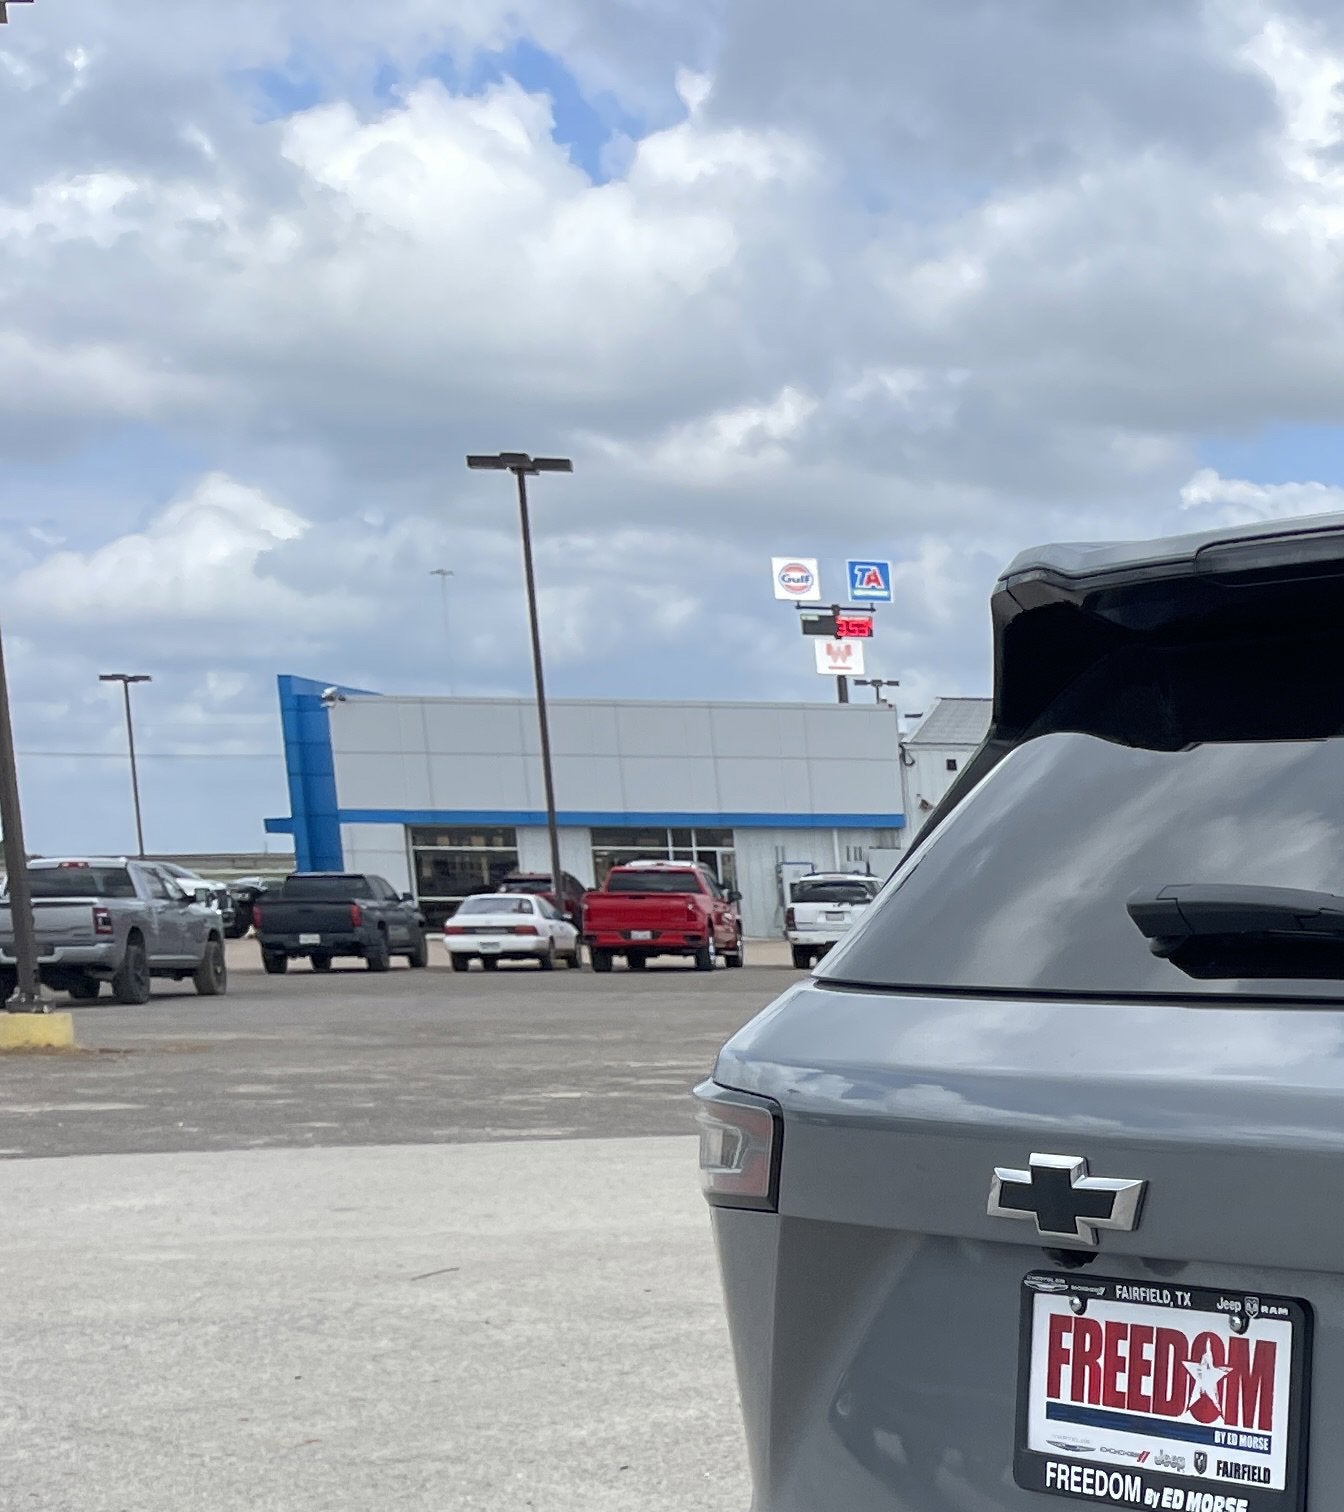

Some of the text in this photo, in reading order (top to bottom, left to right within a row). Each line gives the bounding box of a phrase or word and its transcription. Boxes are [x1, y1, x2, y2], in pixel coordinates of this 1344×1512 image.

[781, 573, 811, 584] Gulf
[855, 565, 885, 589] TA
[1115, 1285, 1174, 1308] FAIRFIELD,
[1175, 1291, 1192, 1307] TX
[1216, 1297, 1242, 1314] Jeep
[1261, 1305, 1289, 1316] RAM
[1047, 1313, 1278, 1430] FREEDOM
[1214, 1430, 1270, 1451] BY ED MORSE
[1153, 1449, 1186, 1473] Jeep
[1216, 1460, 1271, 1485] FAIRFIELD
[1045, 1461, 1142, 1503] FREEDOM
[1161, 1487, 1183, 1510] ED
